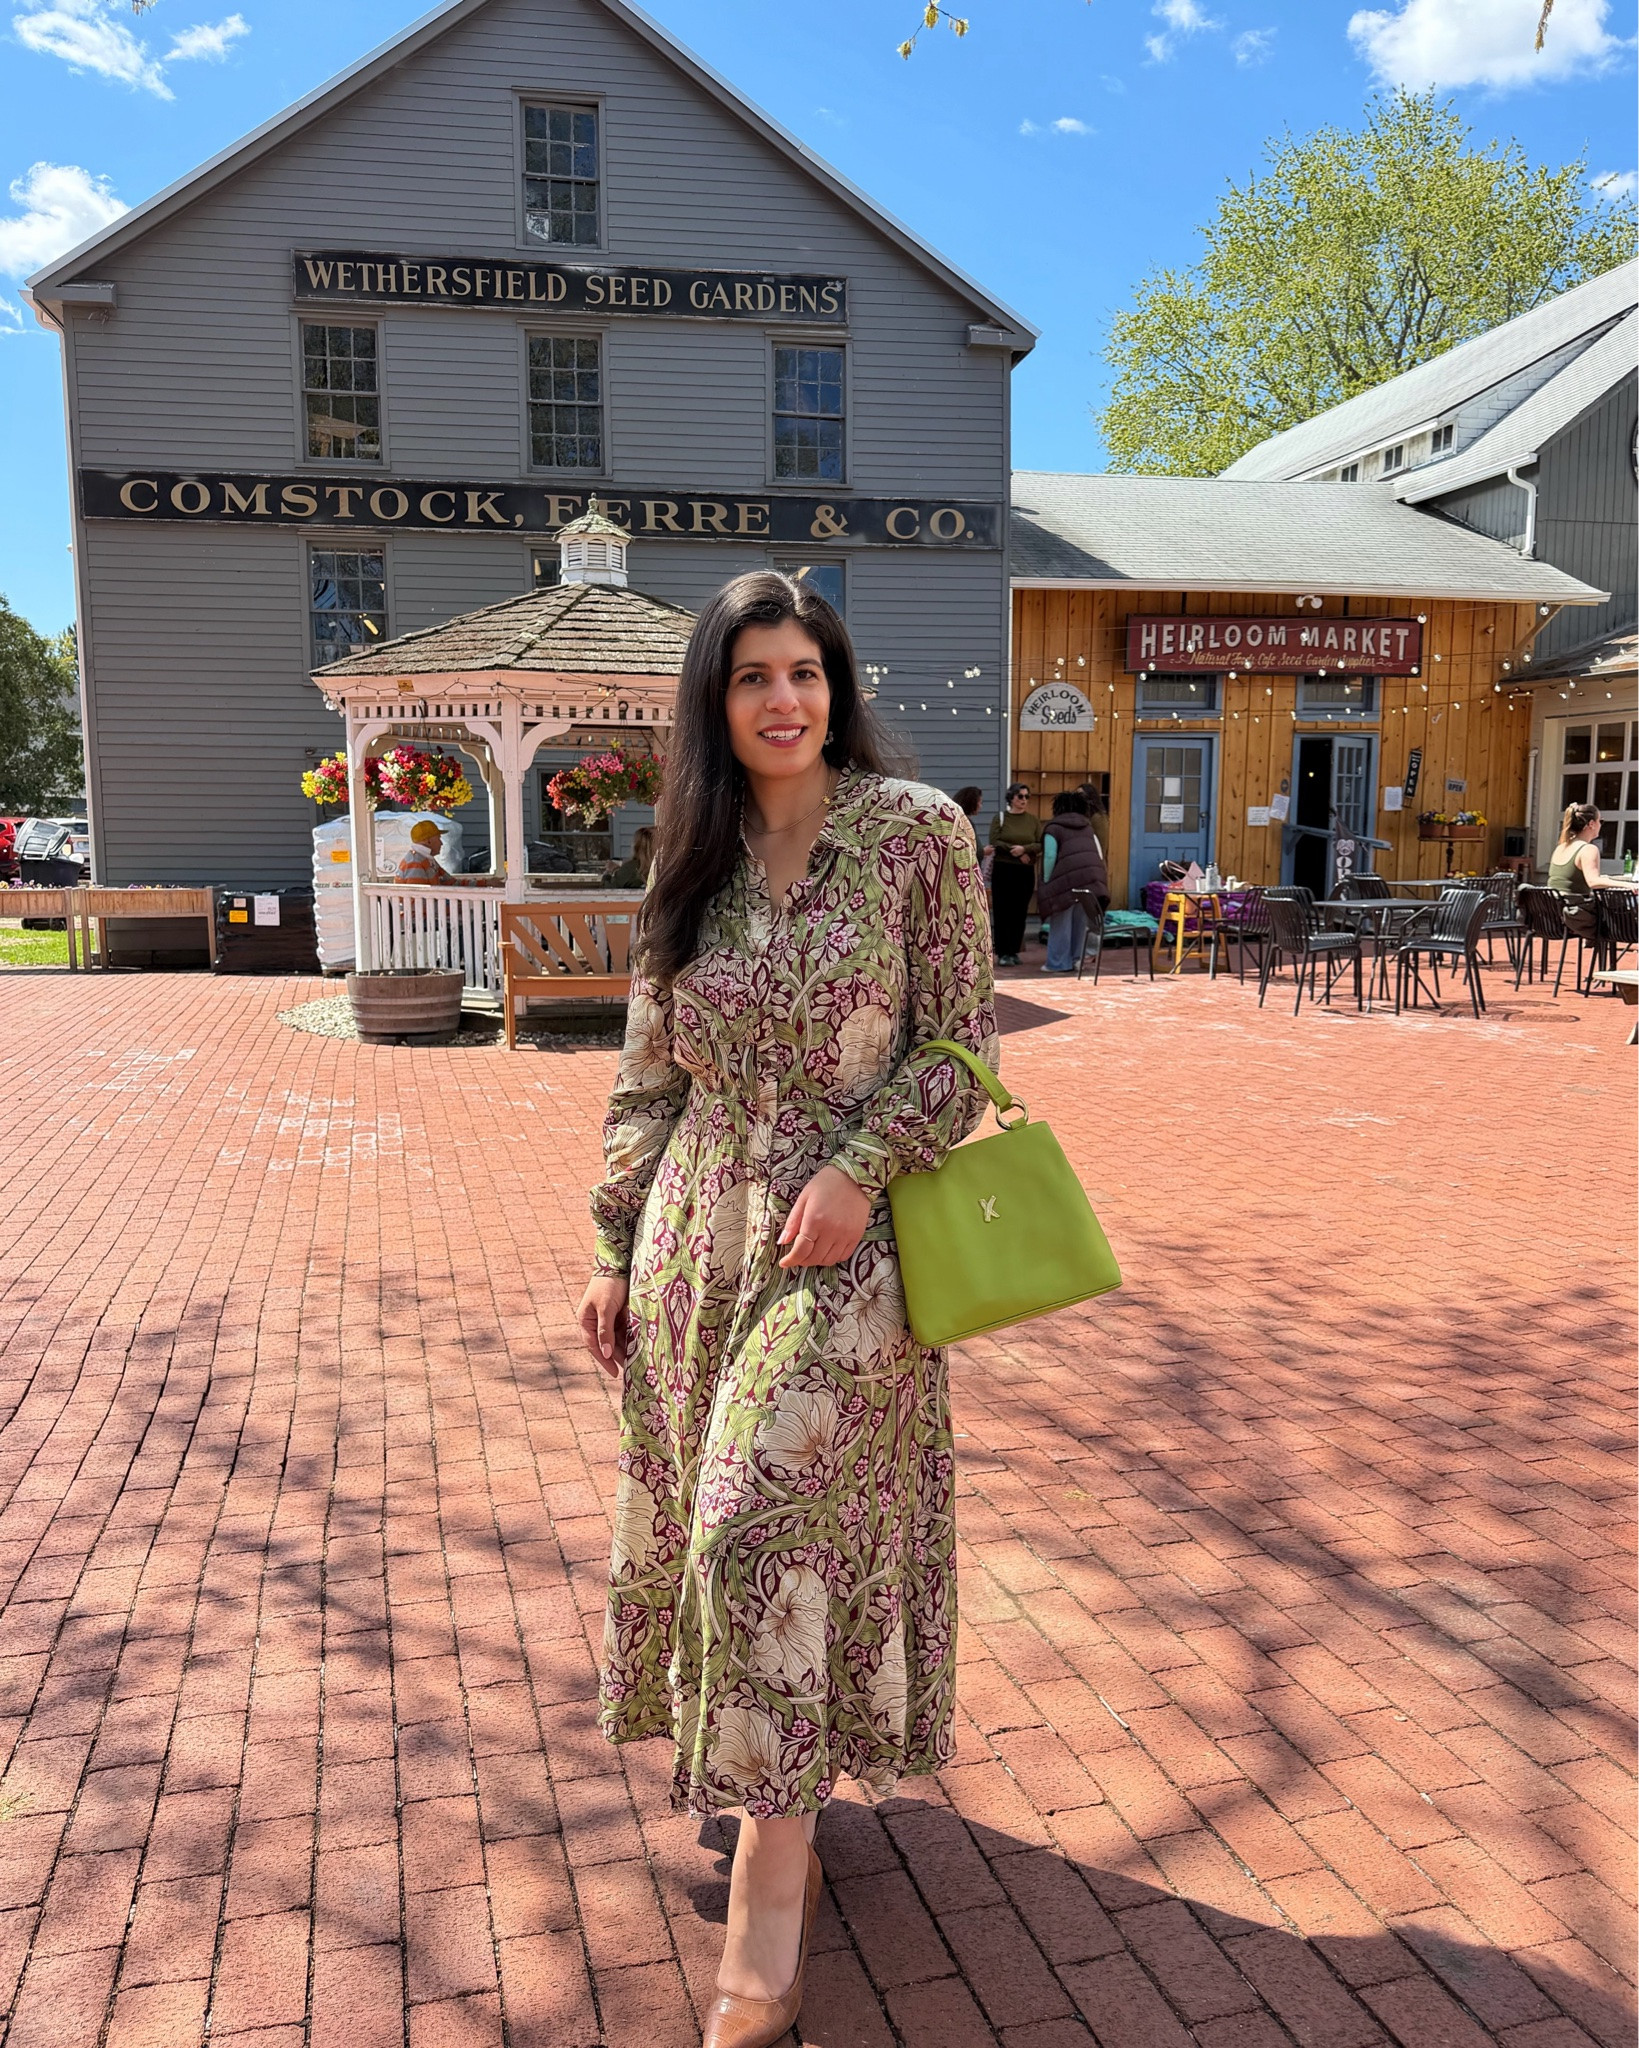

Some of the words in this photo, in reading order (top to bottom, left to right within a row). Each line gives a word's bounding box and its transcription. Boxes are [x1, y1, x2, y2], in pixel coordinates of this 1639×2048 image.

[303, 259, 568, 302] WETHERSFIELD
[584, 274, 673, 307] SEED
[689, 280, 839, 315] GARDENS
[119, 479, 525, 528] COMSTOCK,
[544, 494, 771, 535] FERRE
[810, 503, 850, 539] &
[885, 507, 975, 540] CO.
[1140, 624, 1287, 659] HEIRLOOM
[1300, 626, 1410, 661] MARKET
[1188, 651, 1232, 666] Natural
[1027, 689, 1087, 716] HEIRLOOM
[1040, 705, 1077, 725] Seeds
[1406, 762, 1418, 794] OPEN
